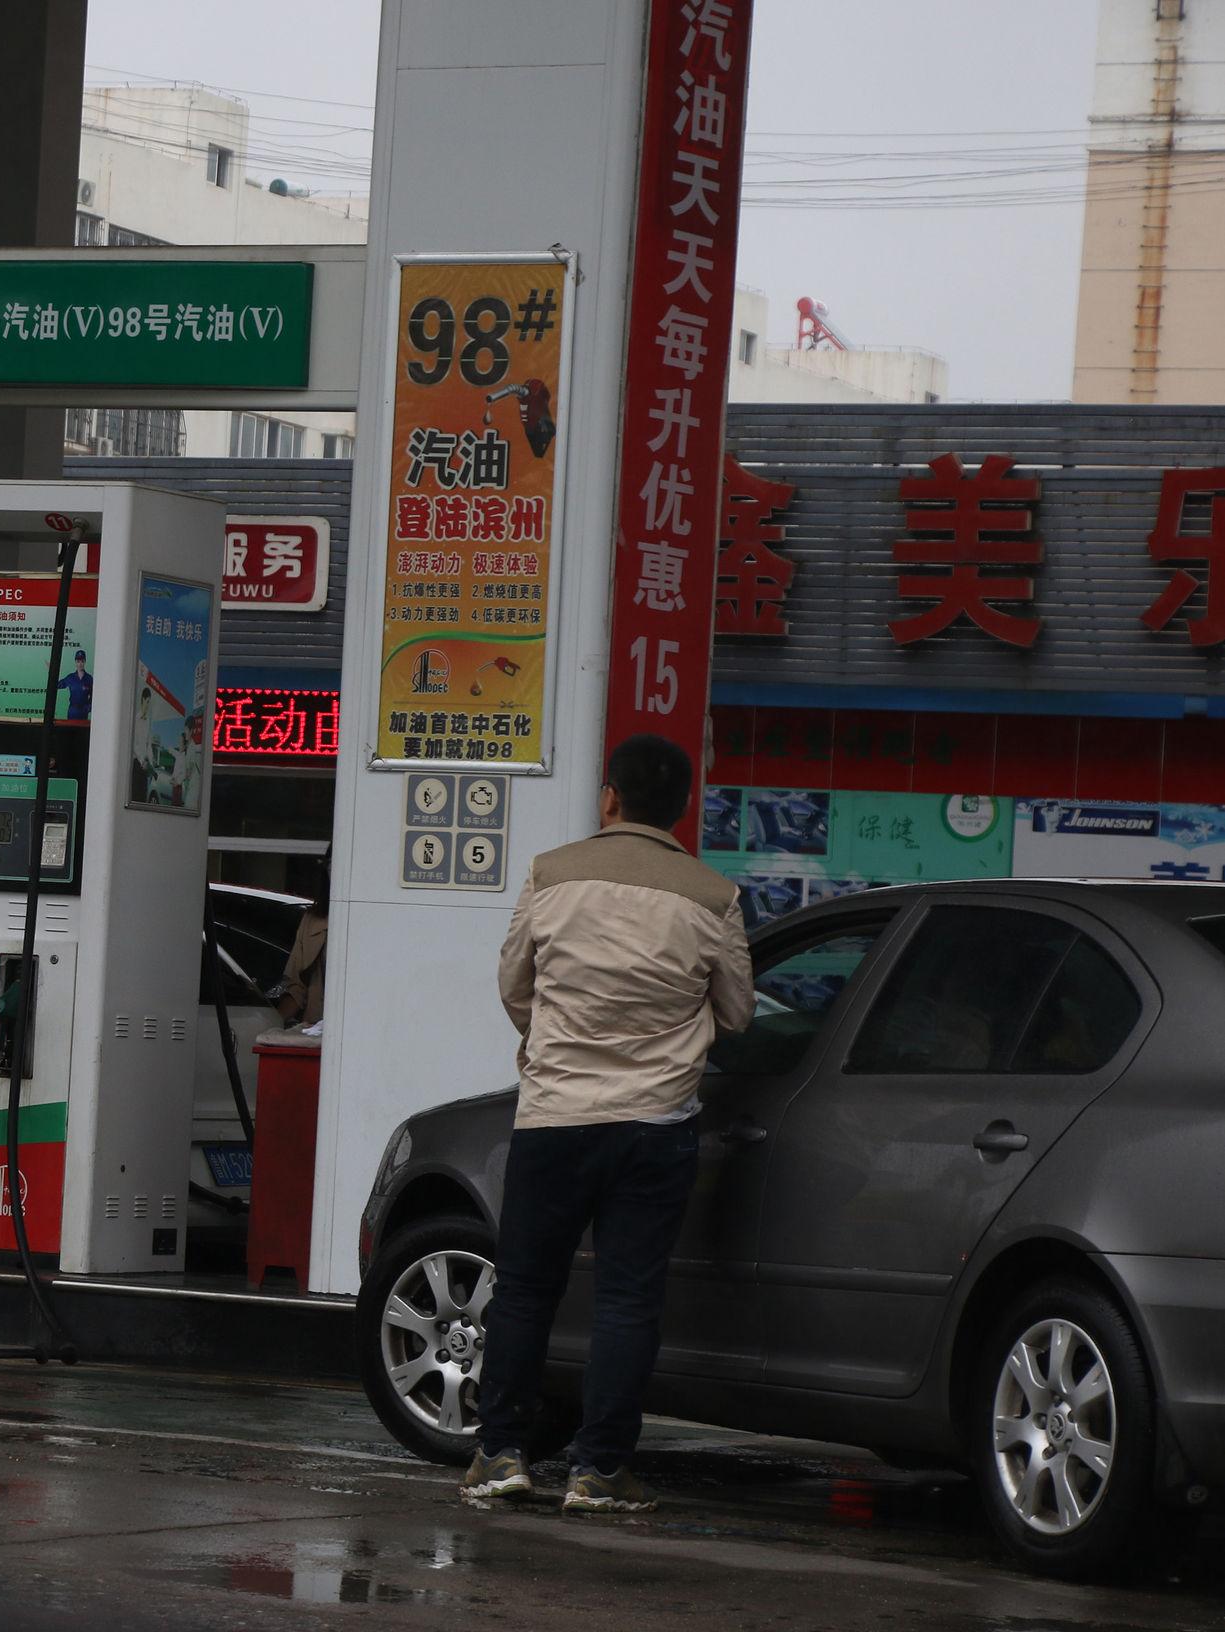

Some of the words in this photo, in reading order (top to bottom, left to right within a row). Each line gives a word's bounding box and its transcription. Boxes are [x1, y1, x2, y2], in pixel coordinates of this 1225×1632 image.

[407, 289, 556, 386] 98#
[405, 427, 510, 490] 汽油
[49, 514, 71, 530] 11
[395, 495, 547, 542] 登陆滨州
[222, 531, 304, 578] 服务
[397, 552, 462, 575] 澎湃动力
[473, 553, 538, 576] 极速体验
[389, 711, 532, 736] 加油首选中石化
[403, 737, 513, 759] 要加就加98
[472, 846, 485, 864] 5
